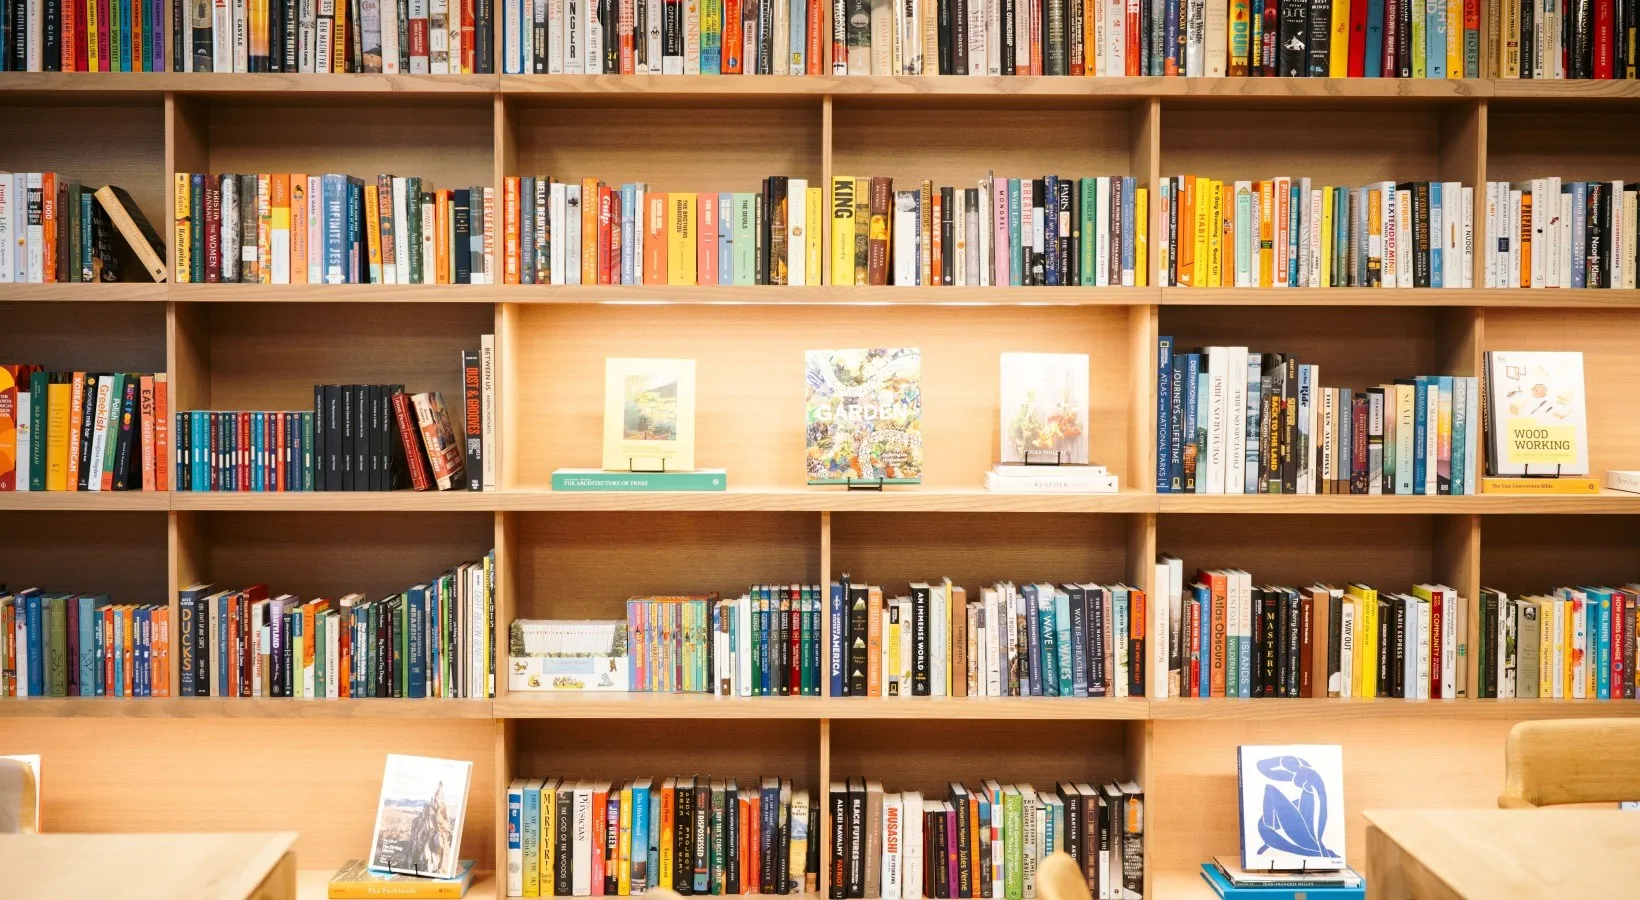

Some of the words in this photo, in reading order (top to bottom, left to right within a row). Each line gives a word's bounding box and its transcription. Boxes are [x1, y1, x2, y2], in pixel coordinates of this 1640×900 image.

[319, 22, 327, 33] BEN
[688, 16, 698, 62] UNRULY
[1232, 22, 1248, 66] DUNE
[1263, 33, 1269, 42] OF
[318, 34, 327, 68] MACINTYRE
[1468, 32, 1477, 64] HORSE
[537, 181, 546, 205] HELLO
[834, 180, 852, 218] KING
[1023, 183, 1031, 226] BREATHE
[329, 201, 341, 244] INFINITE
[484, 198, 493, 256] REVENANT
[536, 207, 546, 247] BEAUTIFUL
[600, 196, 610, 226] Gulp.
[1522, 205, 1531, 242] PREPARED
[177, 228, 186, 267] Homegoing
[1591, 236, 1599, 262] Naomi
[1591, 265, 1599, 285] Klein
[466, 367, 479, 388] DUST
[486, 382, 491, 390] US
[72, 378, 81, 412] KOREAN
[96, 384, 109, 431] Greekish
[110, 398, 120, 420] Polish
[142, 390, 151, 416] EAST
[1271, 396, 1280, 417] BACK
[1287, 398, 1295, 426] SURFER
[1402, 393, 1410, 428] SCALE
[1456, 382, 1464, 427] COASTAL
[467, 399, 480, 434] GROOVES
[1272, 418, 1279, 430] TO
[70, 429, 78, 472] AMERICAN
[1514, 430, 1548, 439] WOOD
[1515, 441, 1570, 450] WORKING
[917, 592, 924, 604] AN
[1215, 595, 1224, 624] Atlas
[182, 609, 192, 670] DUCKS
[1043, 616, 1054, 645] WAVE
[1074, 608, 1082, 637] WAVES
[832, 634, 840, 676] AMERICA
[1061, 643, 1071, 680] WAVES
[1215, 626, 1224, 668] Obscura
[1265, 612, 1275, 677] MASTERY
[1241, 641, 1250, 684] ISLANDS
[578, 794, 588, 841] PHYSICIAN
[608, 806, 617, 825] JOHN
[852, 799, 860, 824] BLACK
[609, 827, 618, 849] GREEN
[887, 808, 898, 853] MUSASHI
